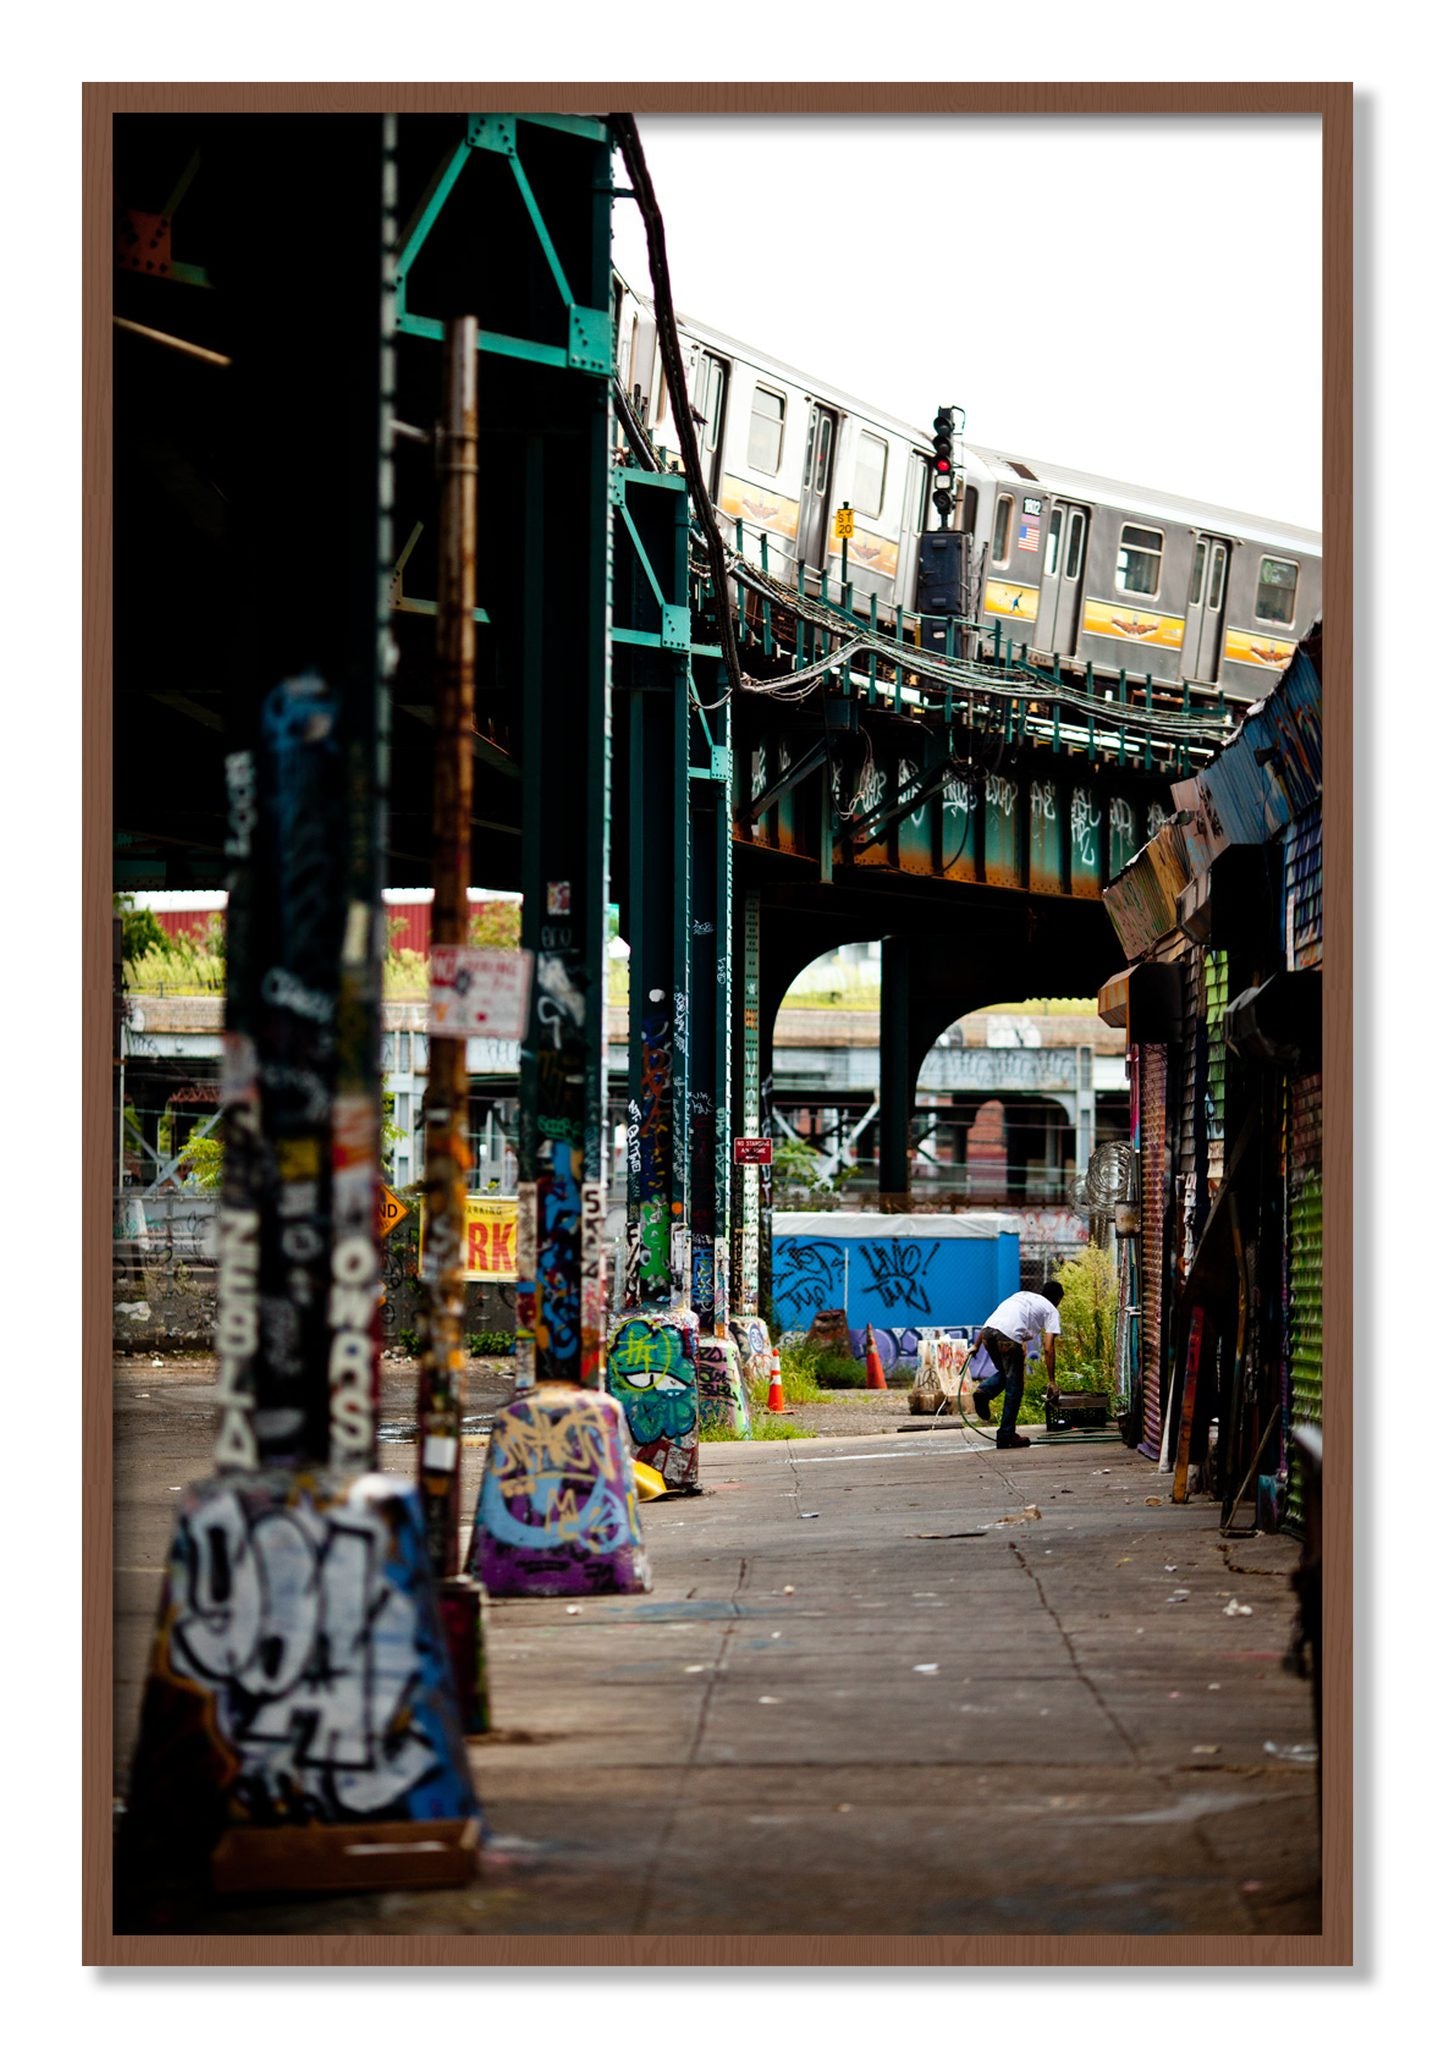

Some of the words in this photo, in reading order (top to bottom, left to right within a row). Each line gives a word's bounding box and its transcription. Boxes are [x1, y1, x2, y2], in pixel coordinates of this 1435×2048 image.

[839, 524, 852, 534] 20
[379, 1203, 398, 1218] ND
[468, 1222, 514, 1271] RK
